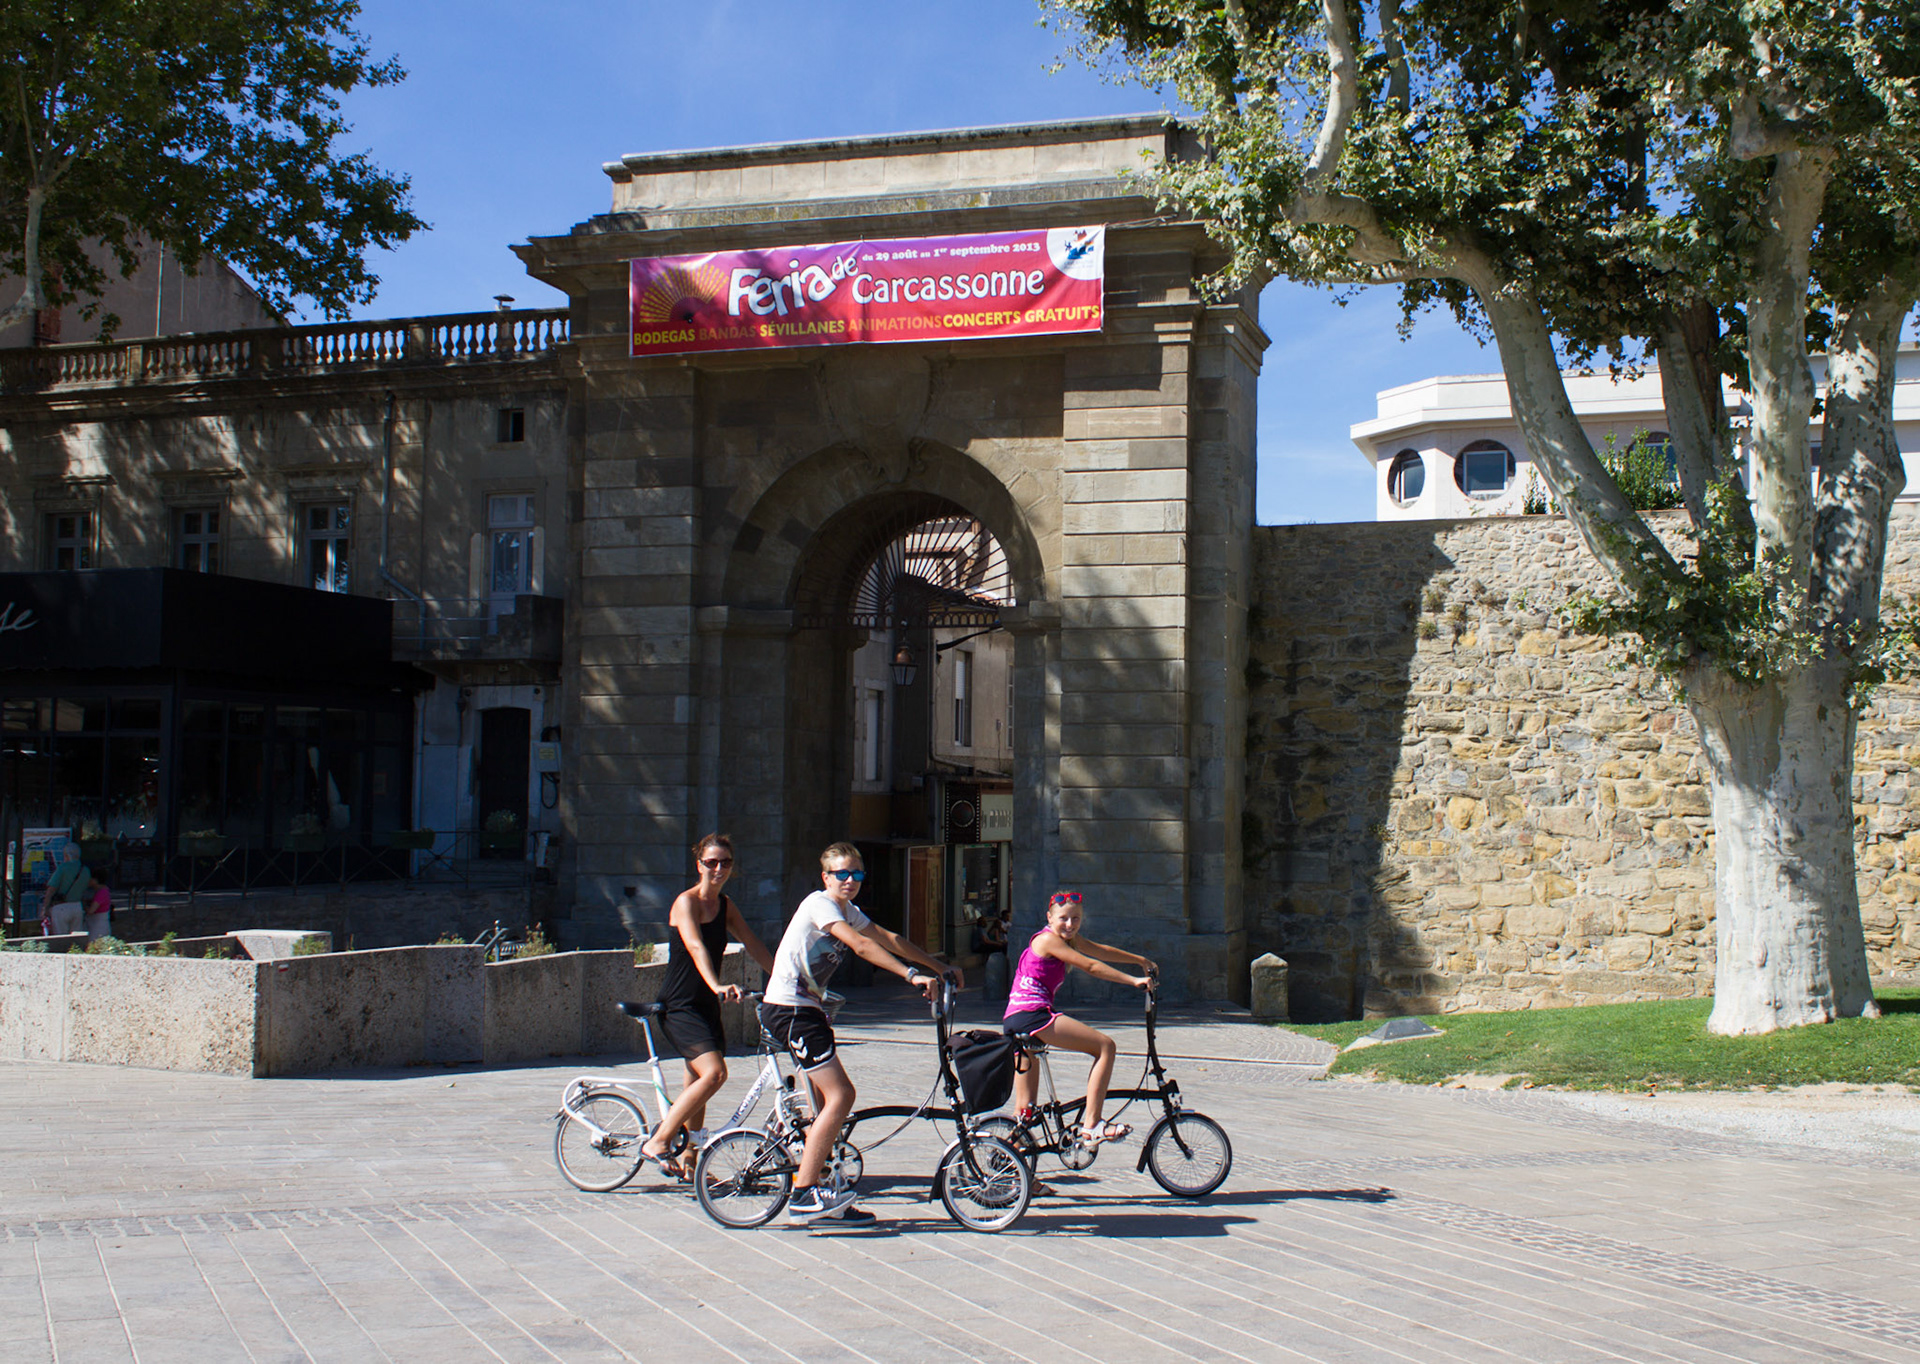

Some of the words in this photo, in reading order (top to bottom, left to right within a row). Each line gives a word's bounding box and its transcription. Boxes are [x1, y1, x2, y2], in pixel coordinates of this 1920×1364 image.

[862, 254, 873, 262] du
[875, 252, 889, 262] 29
[892, 249, 917, 260] août
[933, 247, 948, 257] 1er
[950, 244, 1010, 257] septembre
[1012, 242, 1041, 252] 2013
[728, 259, 837, 316] Feria
[831, 256, 859, 281] de
[851, 269, 1045, 304] Carcassonne
[634, 328, 696, 345] BODEGAS
[699, 325, 756, 341] BANDAS
[759, 320, 845, 336] SÉVILLANES
[848, 315, 942, 331] ANIMATIONS
[943, 311, 1021, 327] CONCERTS
[1024, 305, 1100, 323] GRATUITS
